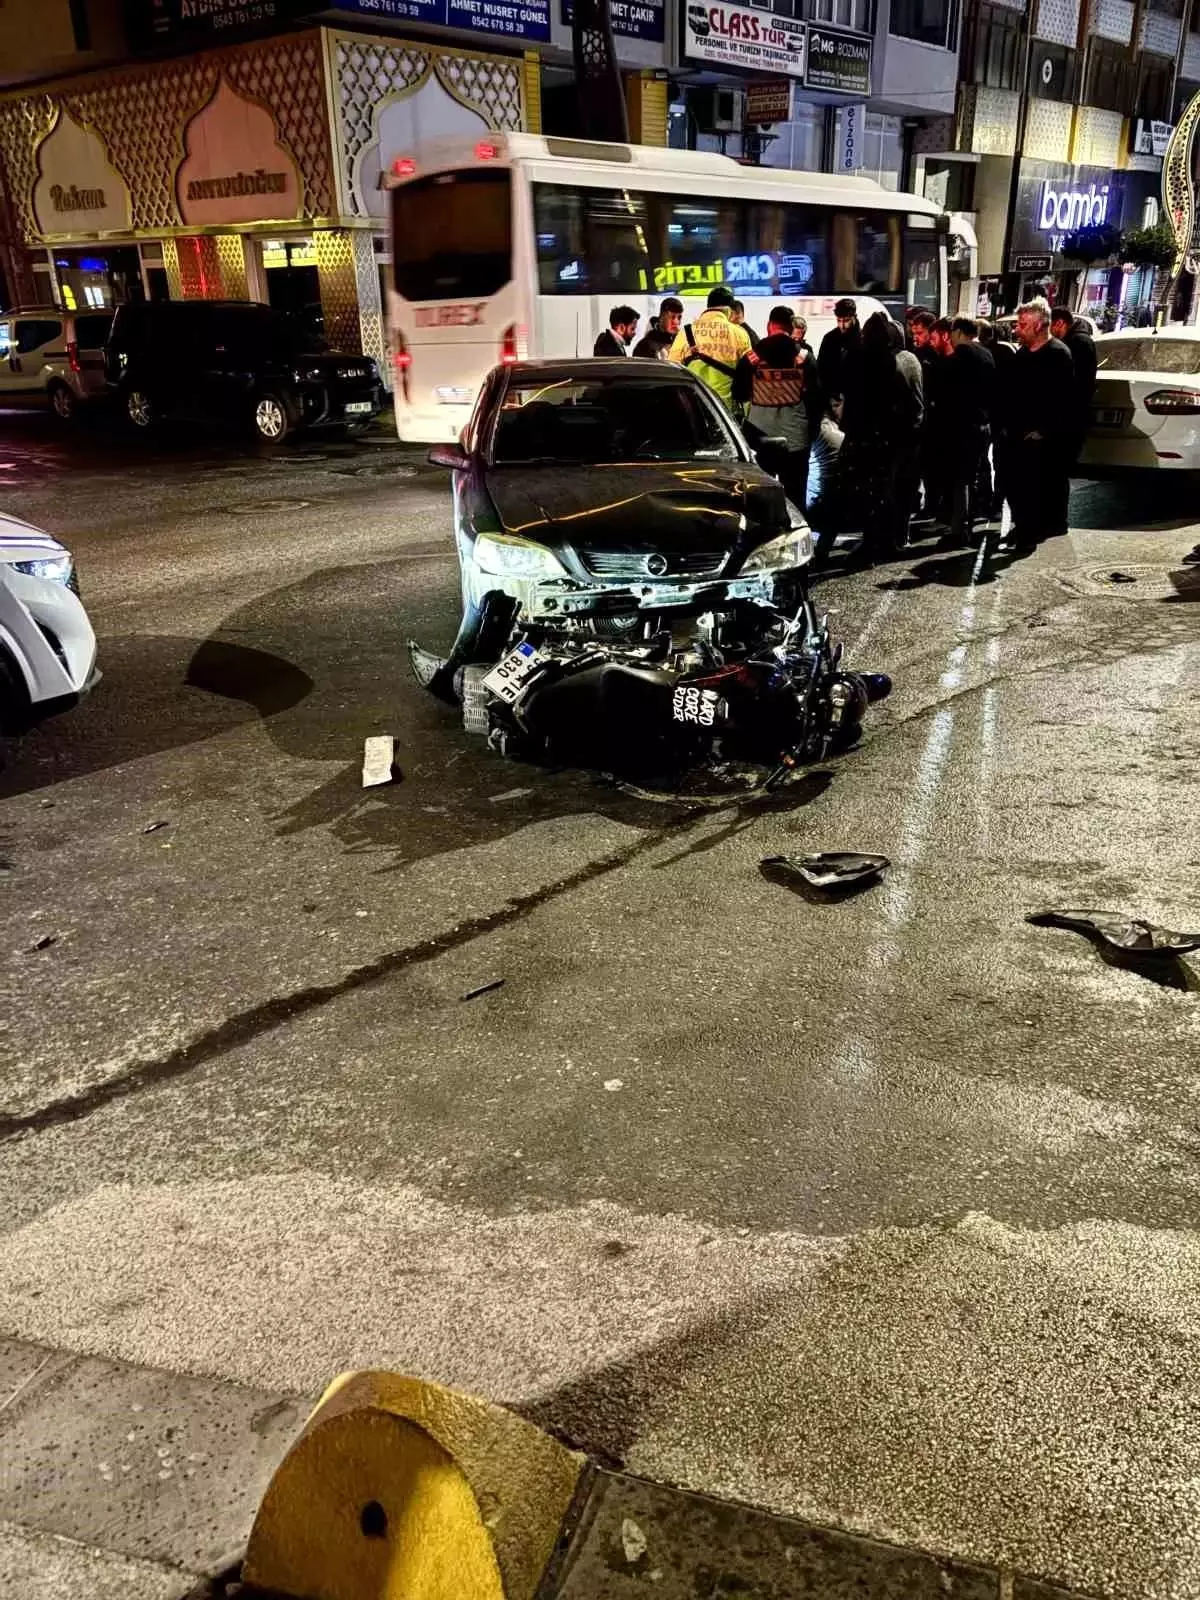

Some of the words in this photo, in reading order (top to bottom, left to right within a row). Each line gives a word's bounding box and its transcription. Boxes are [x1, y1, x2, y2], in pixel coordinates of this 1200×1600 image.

[450, 0, 482, 12] AHMET
[483, 4, 518, 19] NUSRET
[519, 8, 548, 24] GÜNEL
[471, 15, 489, 28] 0542
[630, 6, 656, 22] ÇAKIR
[709, 8, 760, 41] CLASS
[761, 27, 786, 47] TUR
[695, 36, 728, 50] PERSONEL
[729, 42, 738, 52] VE
[820, 39, 835, 54] MG
[837, 42, 870, 61] BOZMAN
[1039, 179, 1110, 231] bambi
[497, 655, 523, 678] 830
[672, 686, 686, 722] RIDER
[684, 687, 700, 724] CORE
